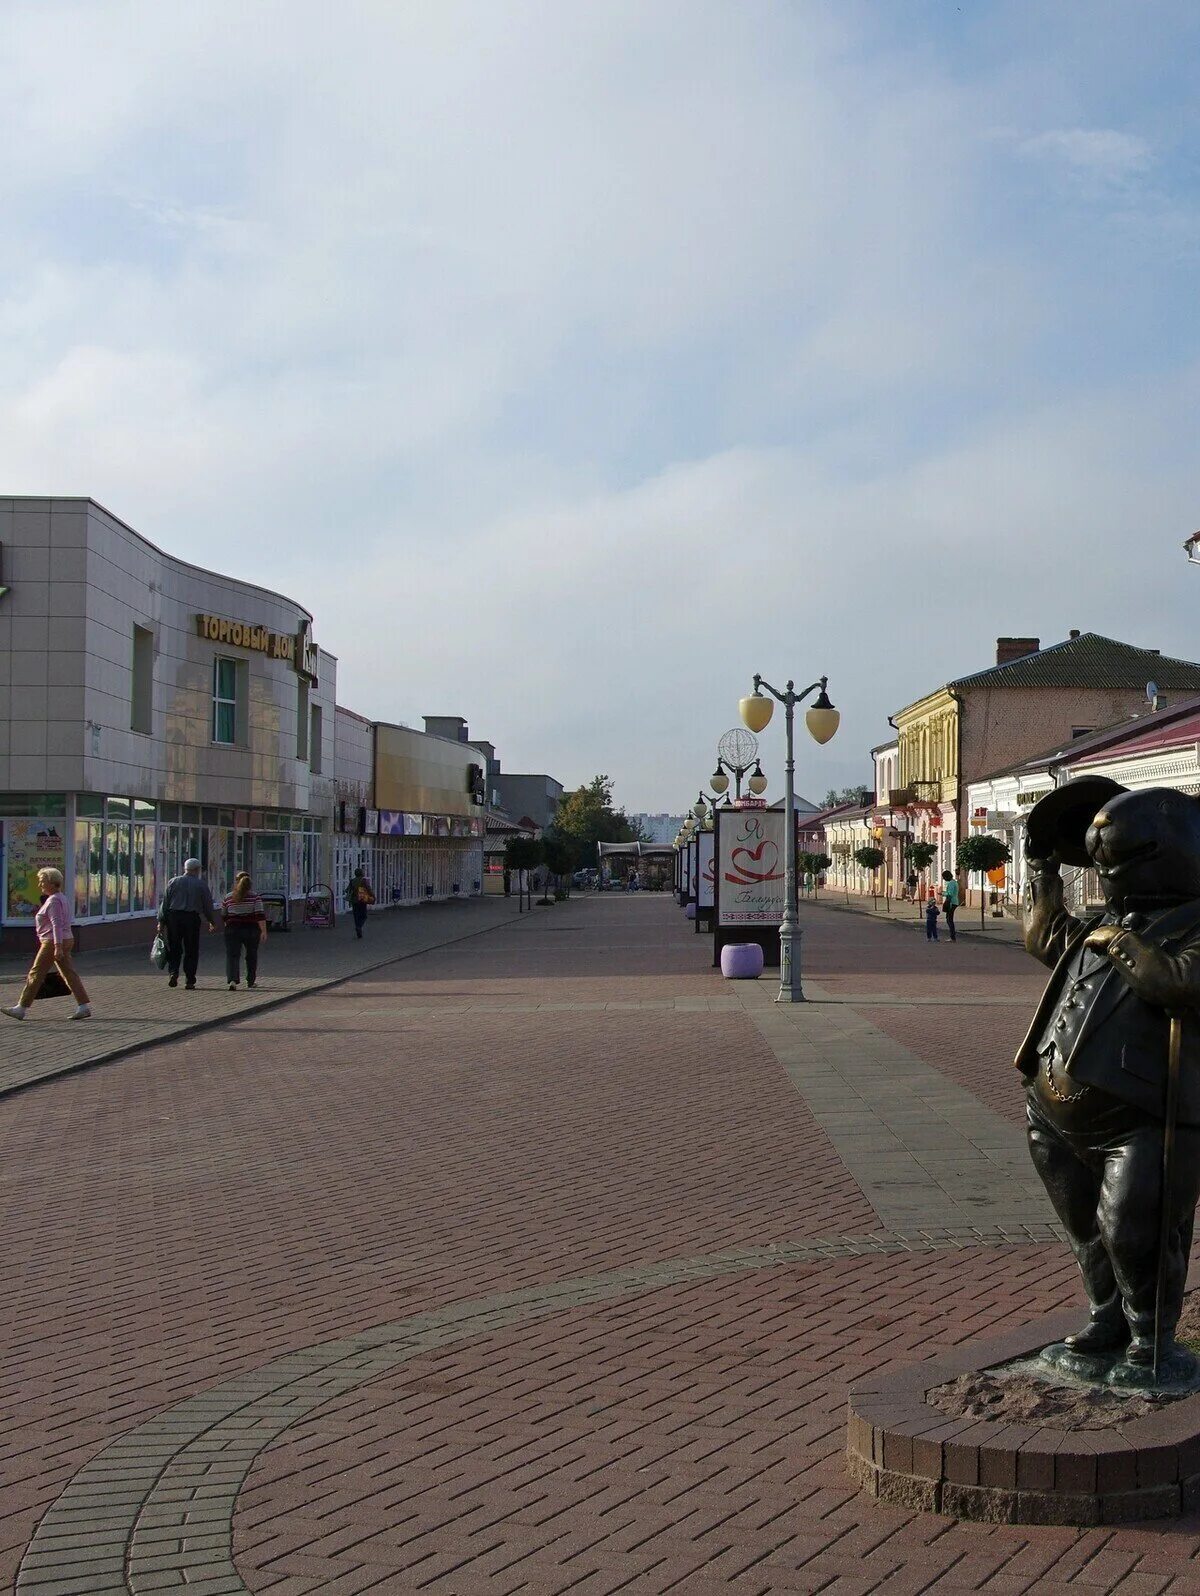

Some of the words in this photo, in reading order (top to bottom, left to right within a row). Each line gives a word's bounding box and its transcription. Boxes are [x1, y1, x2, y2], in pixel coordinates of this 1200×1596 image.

[202, 614, 269, 652] ТОРГОВЫЙ
[273, 634, 296, 660] ДОМ
[737, 817, 764, 842] Я
